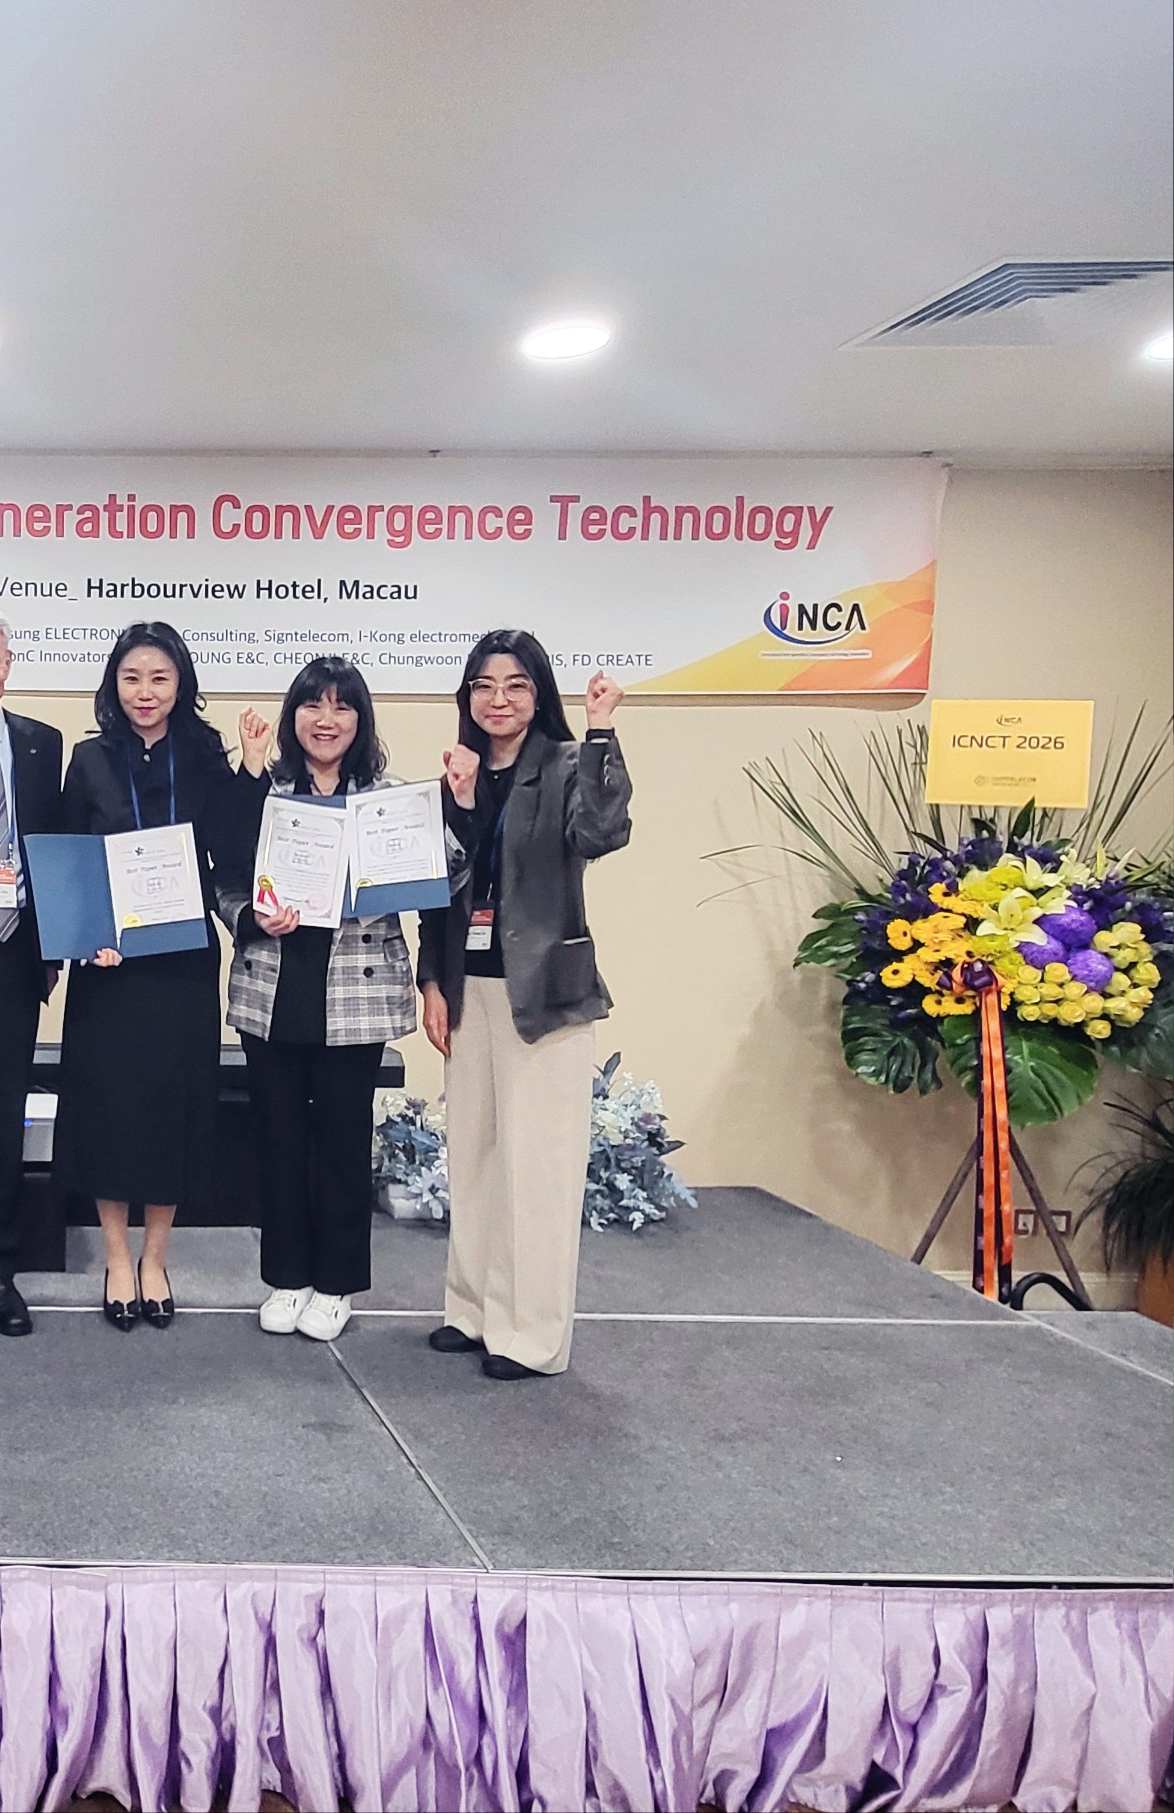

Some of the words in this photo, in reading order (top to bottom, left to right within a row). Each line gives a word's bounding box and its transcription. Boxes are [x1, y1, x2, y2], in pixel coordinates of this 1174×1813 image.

[212, 494, 534, 549] Convergence
[549, 495, 834, 550] Technology
[86, 578, 246, 599] Harbourview
[255, 578, 328, 603] Hotel,
[338, 579, 419, 600] Macau
[45, 627, 125, 641] ELECTRON
[182, 628, 259, 644] Consulting,
[264, 629, 353, 644] Signtelecom,
[359, 629, 405, 645] I-Kong
[236, 651, 268, 666] E&C,
[379, 653, 462, 667] Chungwoon
[572, 653, 592, 666] FD
[597, 653, 653, 667] CREATE
[952, 734, 1012, 749] ICNCT
[1016, 736, 1065, 750] 2026
